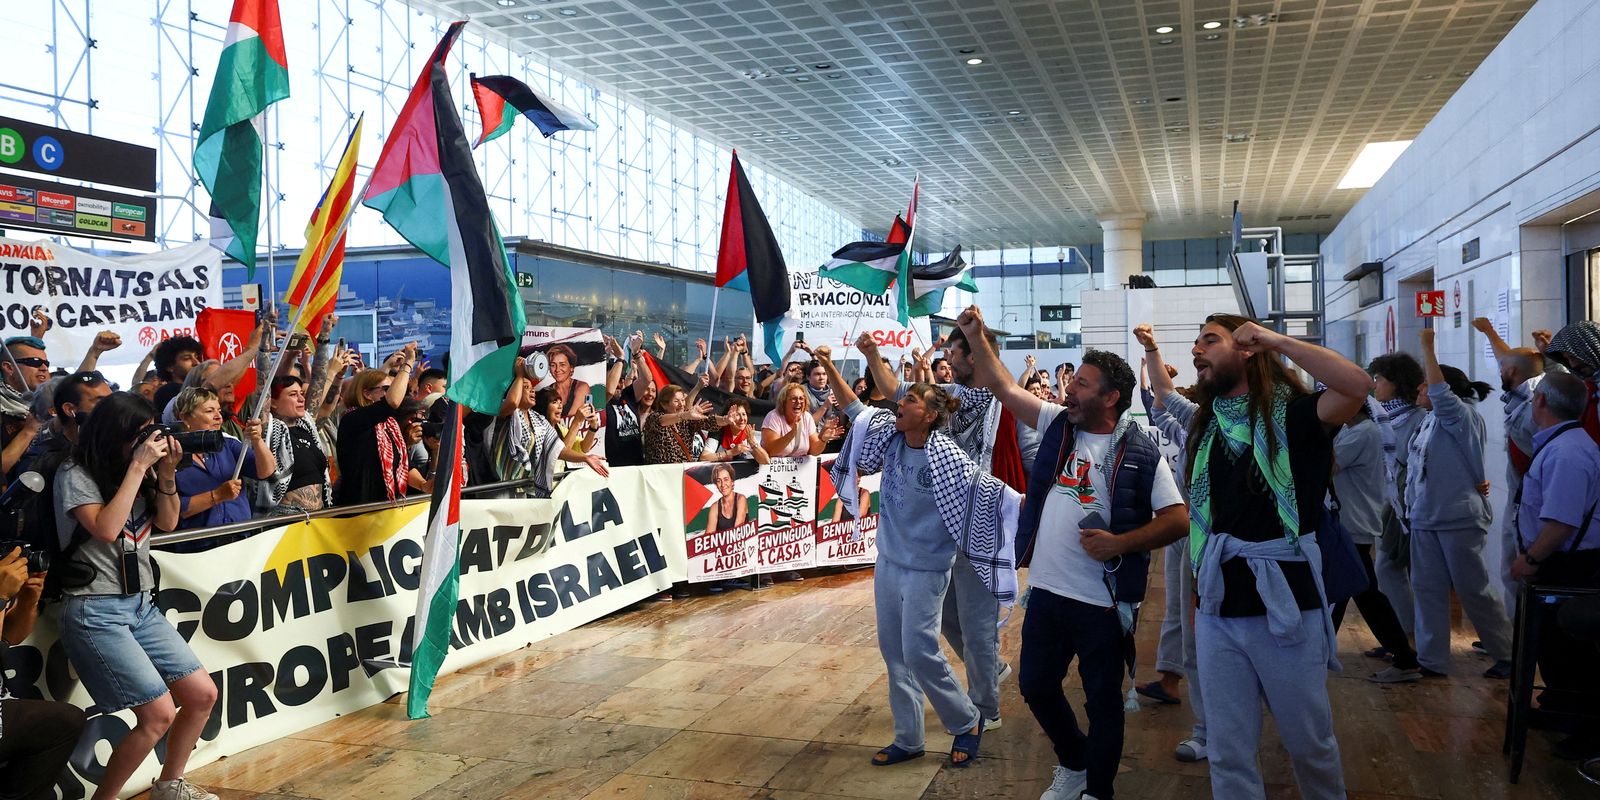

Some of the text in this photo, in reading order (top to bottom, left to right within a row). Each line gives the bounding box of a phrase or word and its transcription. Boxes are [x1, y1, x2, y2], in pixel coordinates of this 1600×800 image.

[1, 134, 56, 164] B C
[115, 205, 144, 216] Europcar
[79, 218, 108, 227] GOLDCAR
[0, 264, 209, 298] TORNATS ALS
[799, 292, 889, 306] RNACIONAL
[56, 296, 206, 328] CATALANS
[821, 311, 874, 319] INTERNACIONAL
[521, 329, 549, 338] omuns
[768, 457, 785, 465] LOBAL
[769, 465, 798, 473] FLOTILLA
[694, 522, 757, 552] BENVINGUDA
[758, 525, 813, 551] ENVINGUDA
[838, 536, 843, 545] A
[715, 542, 746, 558] A CASA
[768, 542, 801, 568] CASA
[828, 541, 866, 559] LAURA
[155, 525, 524, 644] COMPLICAT
[559, 487, 624, 542] LA
[703, 554, 748, 574] LAURA
[791, 561, 809, 569] comuns
[516, 529, 668, 624] ISRAEL
